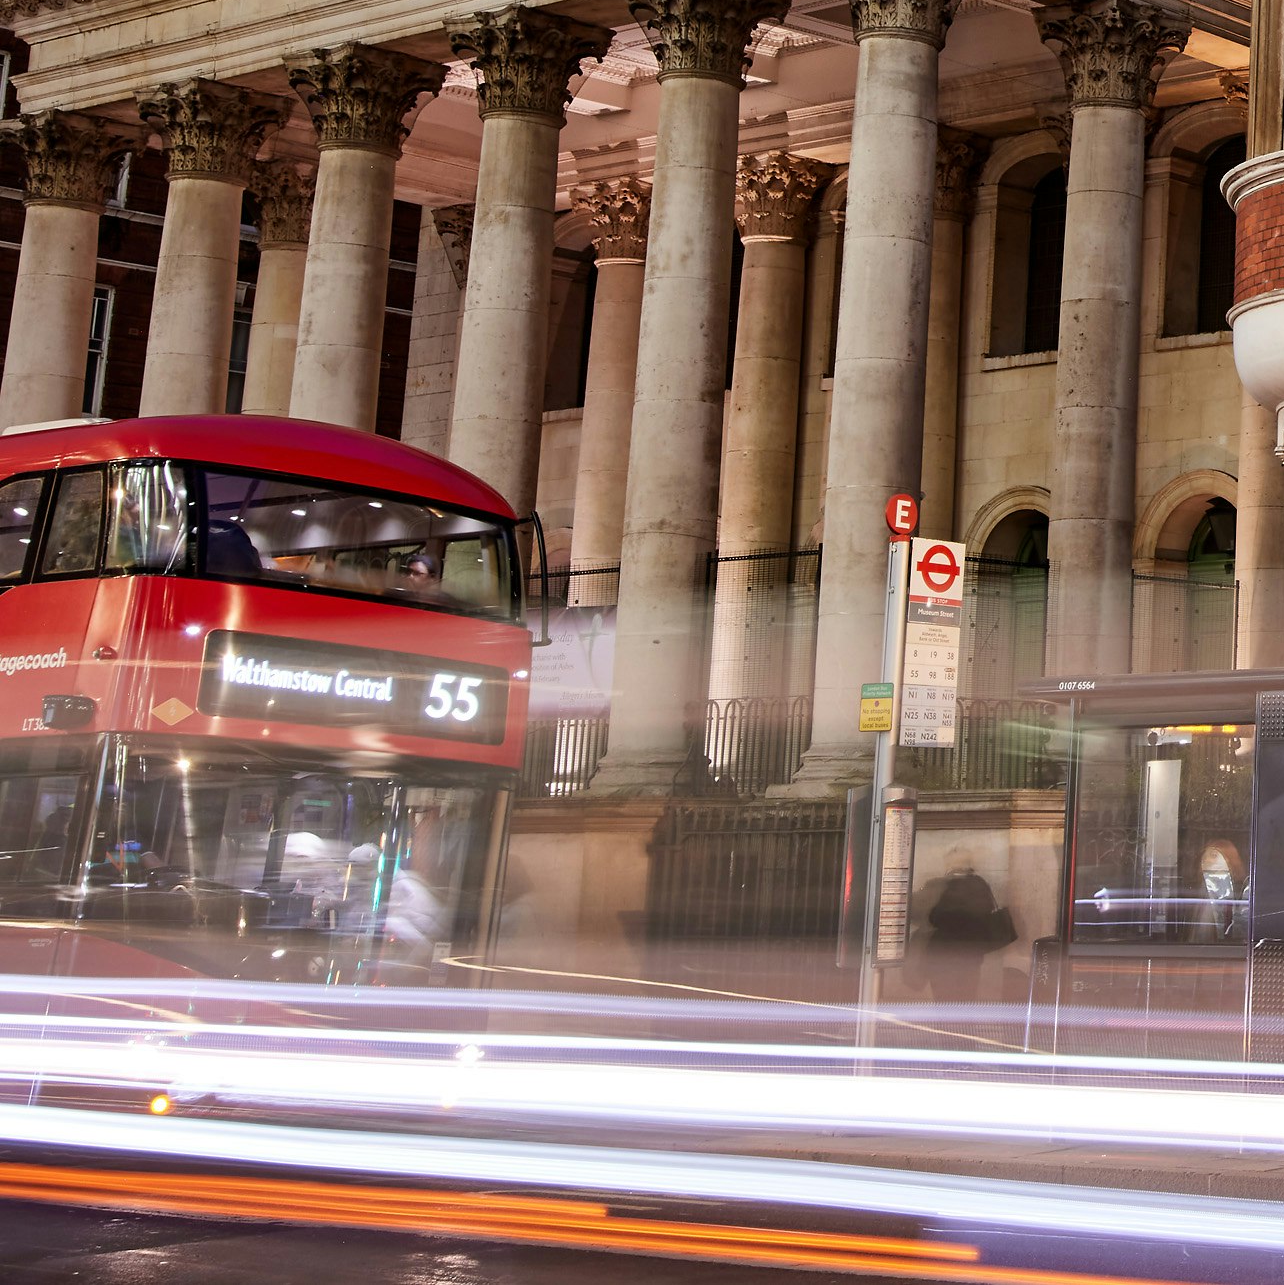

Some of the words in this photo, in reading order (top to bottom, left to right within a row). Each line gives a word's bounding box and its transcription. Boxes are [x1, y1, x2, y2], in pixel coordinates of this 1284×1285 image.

[896, 499, 911, 529] E
[917, 608, 939, 616] Museum
[940, 610, 954, 618] Street
[947, 652, 955, 660] 38
[0, 647, 66, 676] agecoach
[910, 670, 919, 678] 55
[929, 671, 937, 679] 98
[222, 654, 331, 694] Walthamstow
[335, 670, 393, 702] Central
[425, 673, 482, 721] 55
[1059, 682, 1077, 690] 0107
[1077, 681, 1095, 689] 6564
[908, 691, 918, 699] N1
[927, 692, 936, 700] N8
[942, 693, 954, 701] N19
[904, 712, 919, 720] N25
[22, 718, 50, 731] LT38
[920, 733, 937, 741] N242
